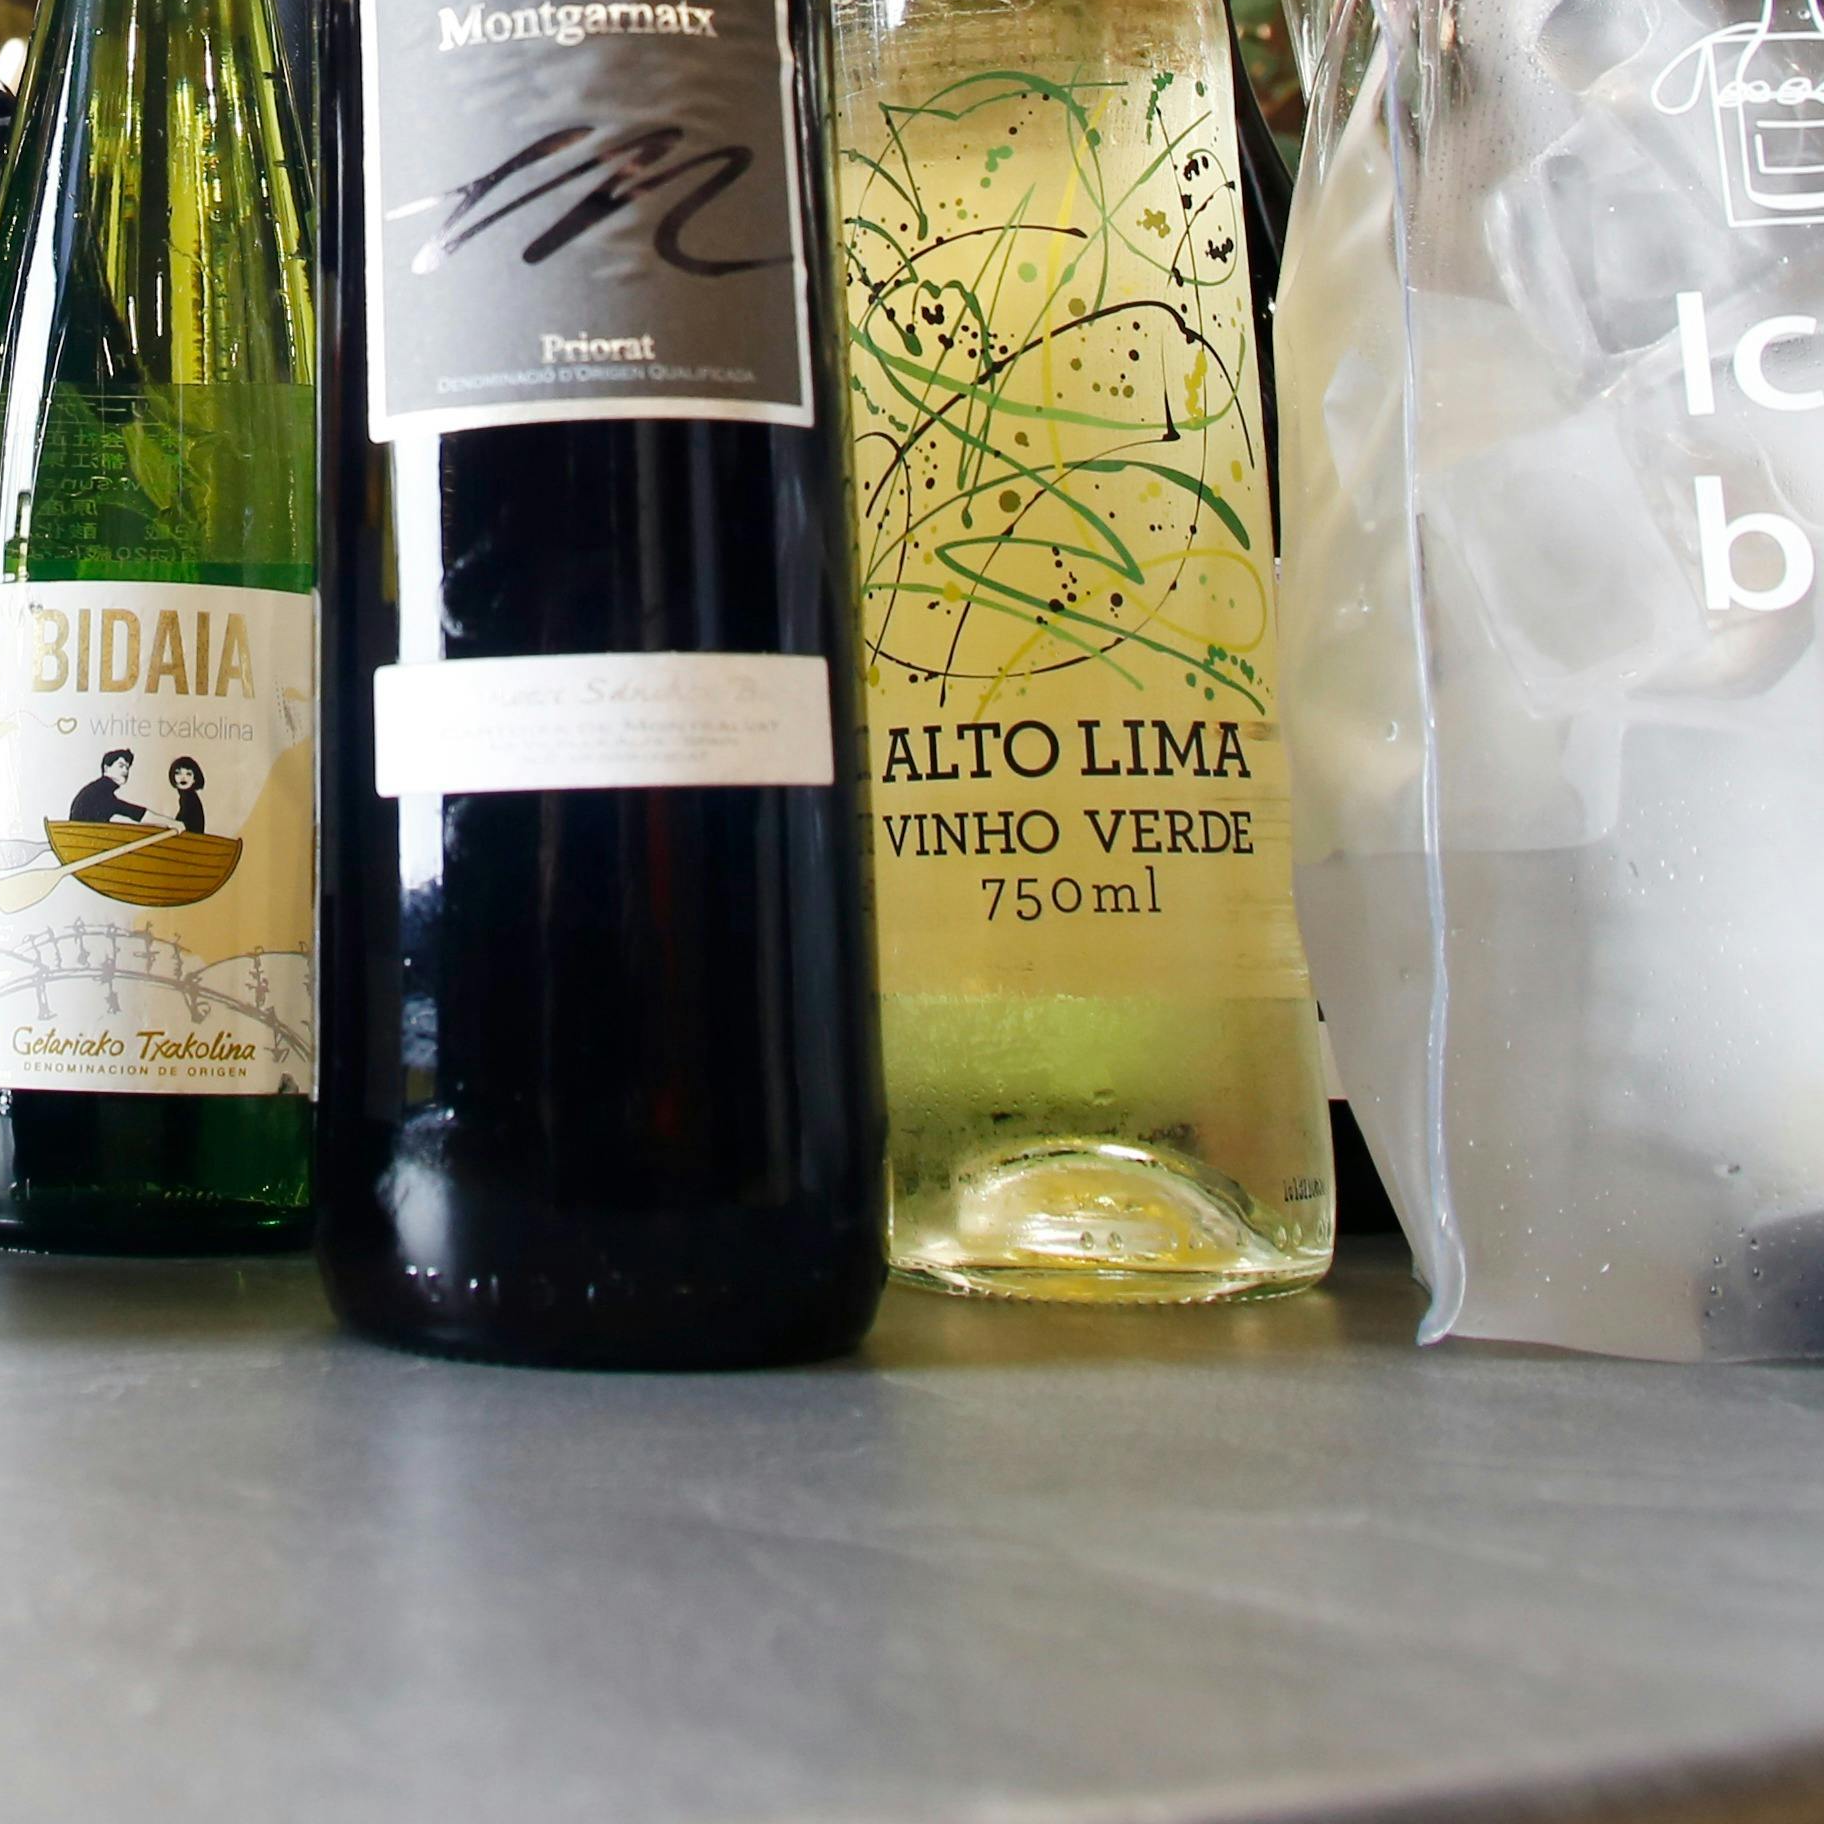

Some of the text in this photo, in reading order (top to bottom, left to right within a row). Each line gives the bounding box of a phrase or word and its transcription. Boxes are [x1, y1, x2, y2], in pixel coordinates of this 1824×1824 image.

[437, 0, 718, 52] Montgarnatx
[541, 331, 655, 363] Priorat
[32, 607, 256, 700] BIDAIA
[89, 715, 254, 741] white txakolina
[882, 719, 1252, 782] ALTO LIMA
[882, 809, 1254, 857] VINHO VERDE
[12, 1026, 255, 1062] Getariako Txakolina
[23, 1062, 247, 1078] DENOMINACION DE ORIGEN
